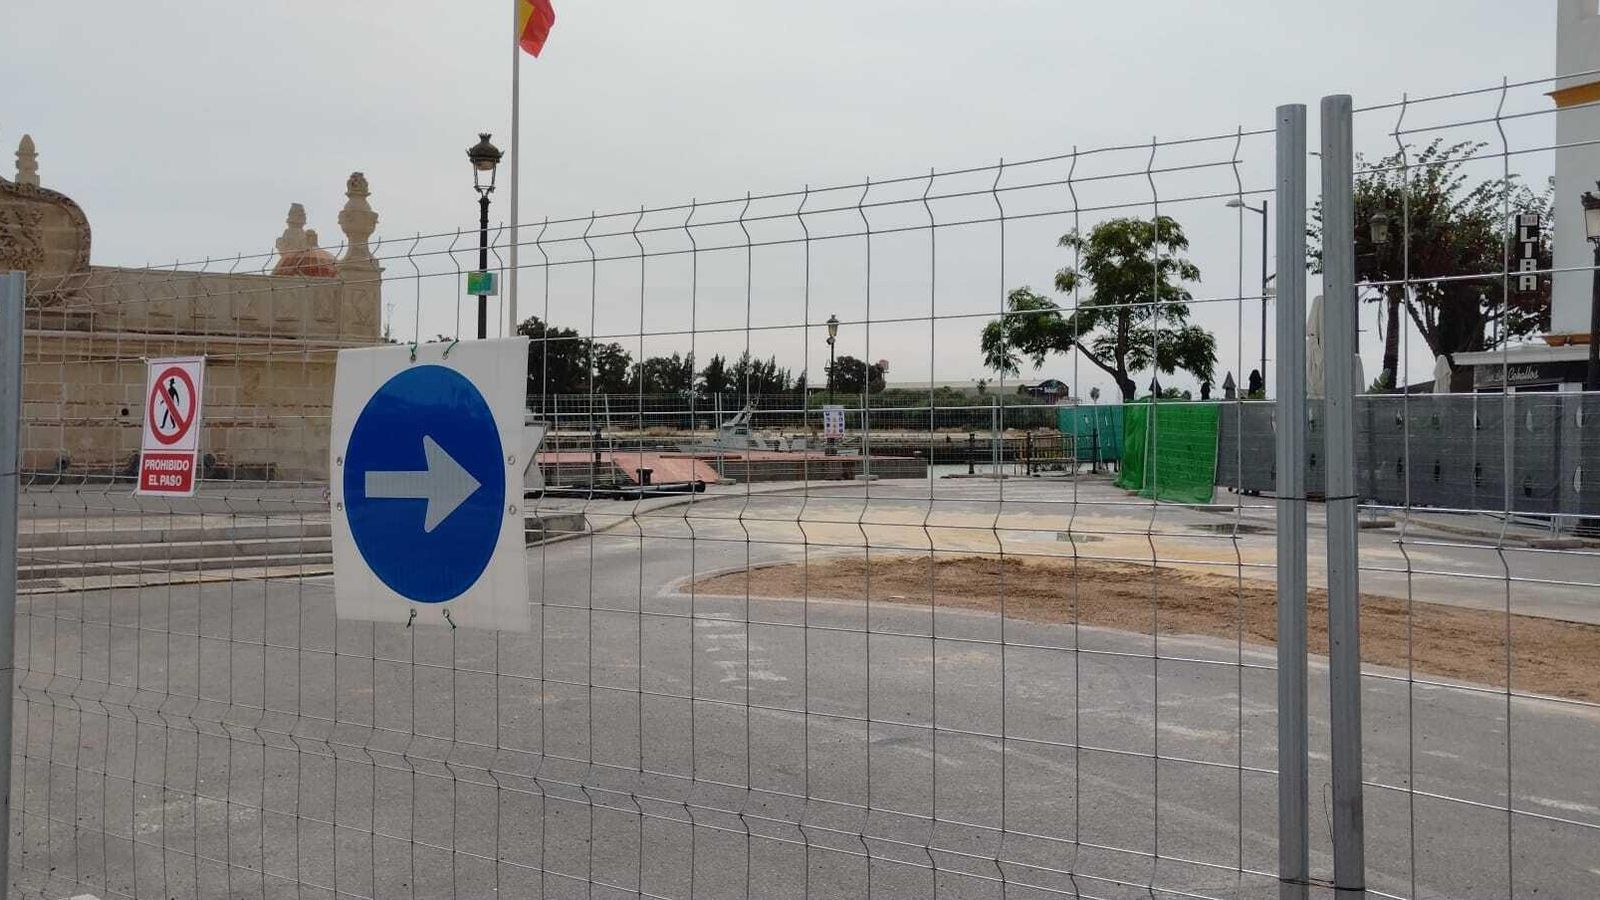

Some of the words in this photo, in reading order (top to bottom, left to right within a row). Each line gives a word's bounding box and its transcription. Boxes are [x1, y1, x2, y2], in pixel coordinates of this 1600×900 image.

[144, 459, 190, 471] PROHIBIDO
[148, 474, 159, 486] EL
[160, 475, 182, 487] PASO
